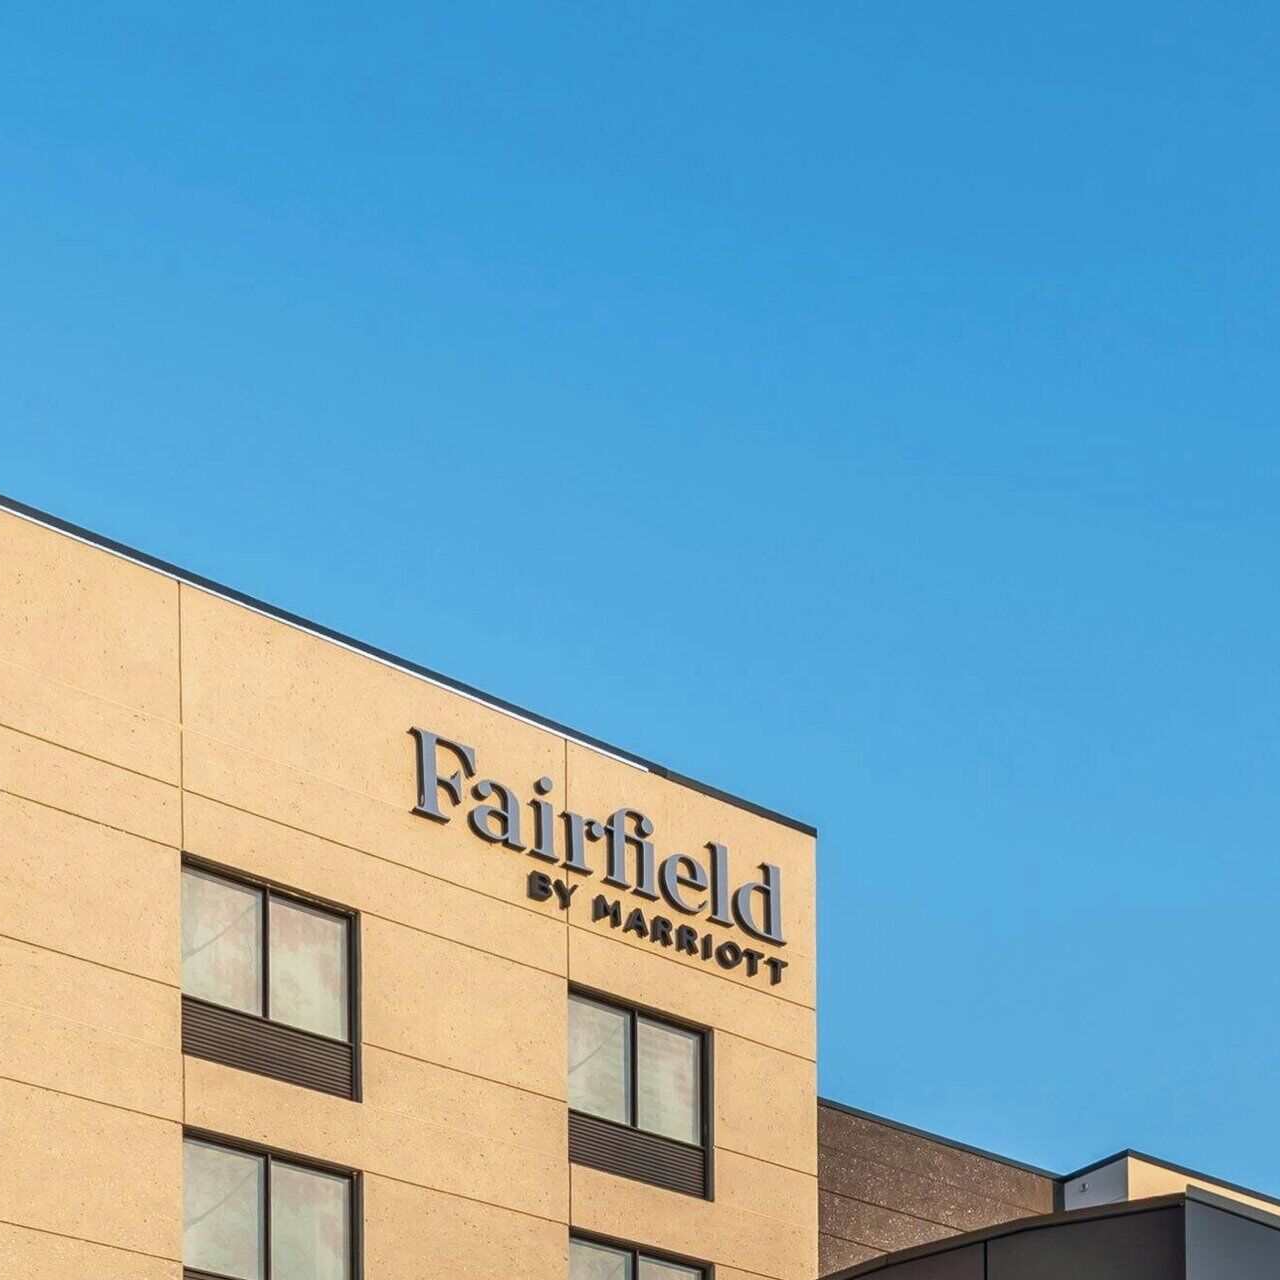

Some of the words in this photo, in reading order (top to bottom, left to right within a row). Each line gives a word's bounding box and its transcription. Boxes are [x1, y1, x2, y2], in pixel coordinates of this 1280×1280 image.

[407, 726, 787, 947] Fairfield
[527, 870, 578, 909] BY
[591, 894, 788, 985] MARRIOTT
